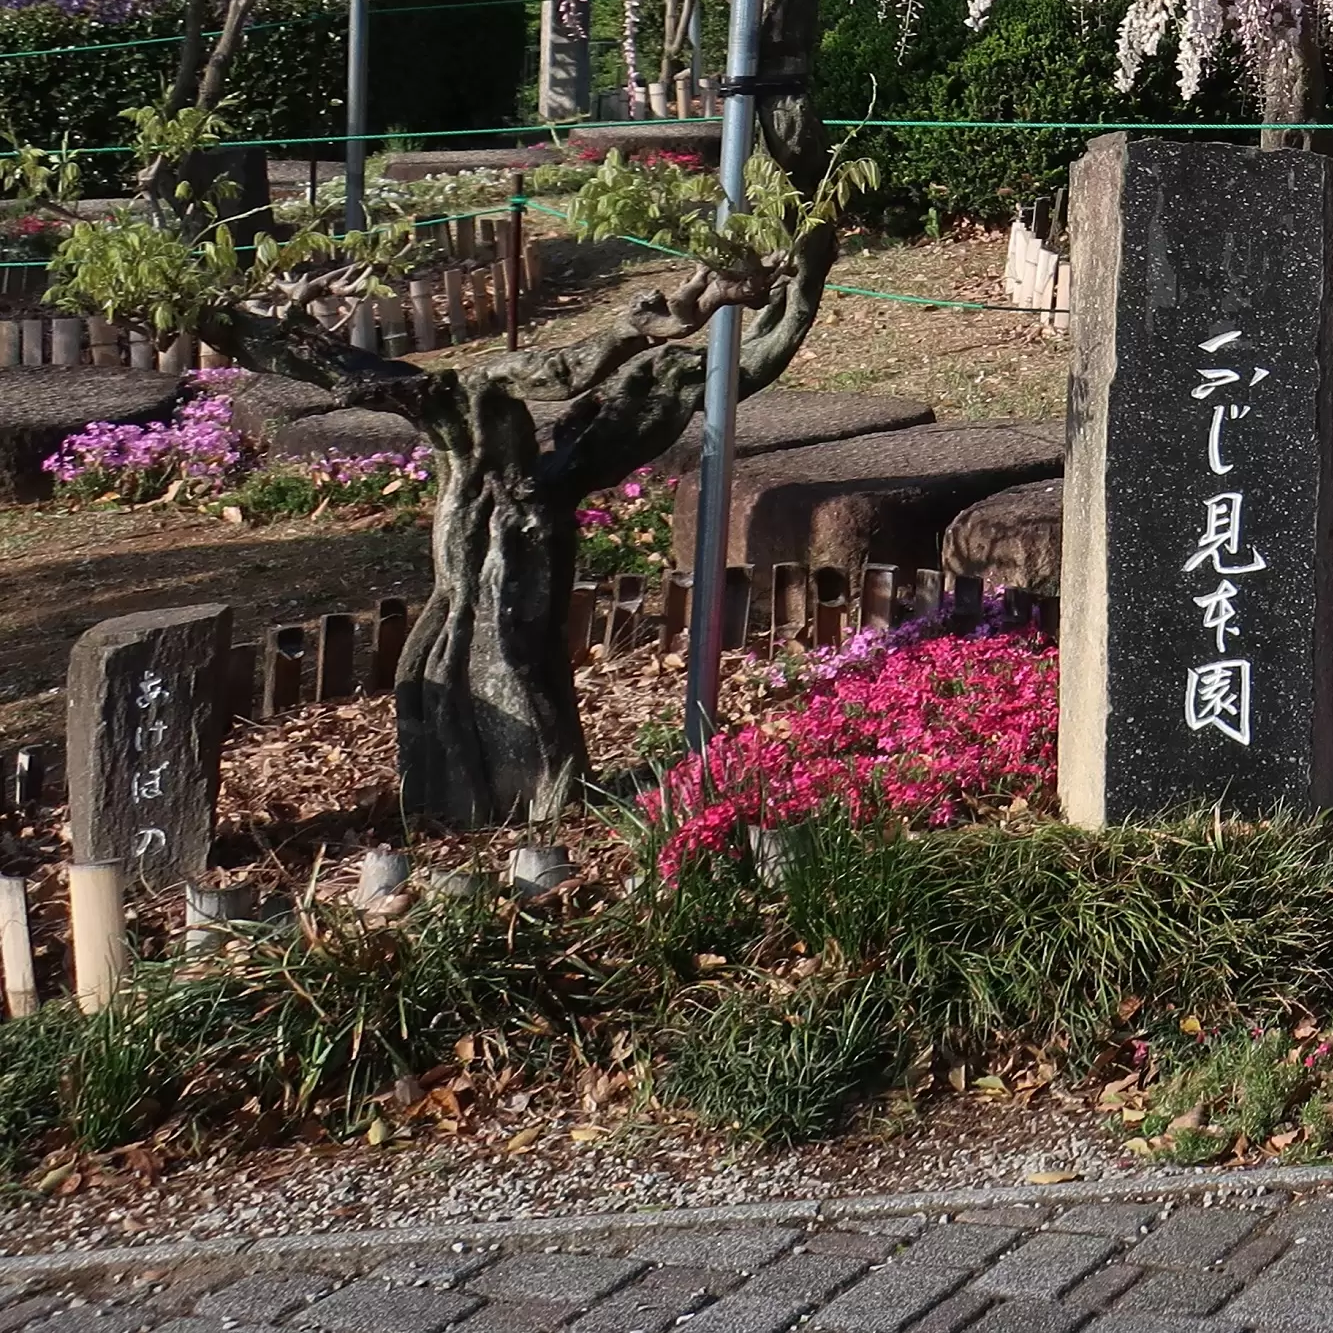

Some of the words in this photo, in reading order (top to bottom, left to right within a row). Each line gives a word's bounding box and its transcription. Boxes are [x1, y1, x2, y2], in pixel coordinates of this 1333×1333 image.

[1182, 331, 1270, 745] ふじ見本園
[131, 670, 170, 858] あけぼの
